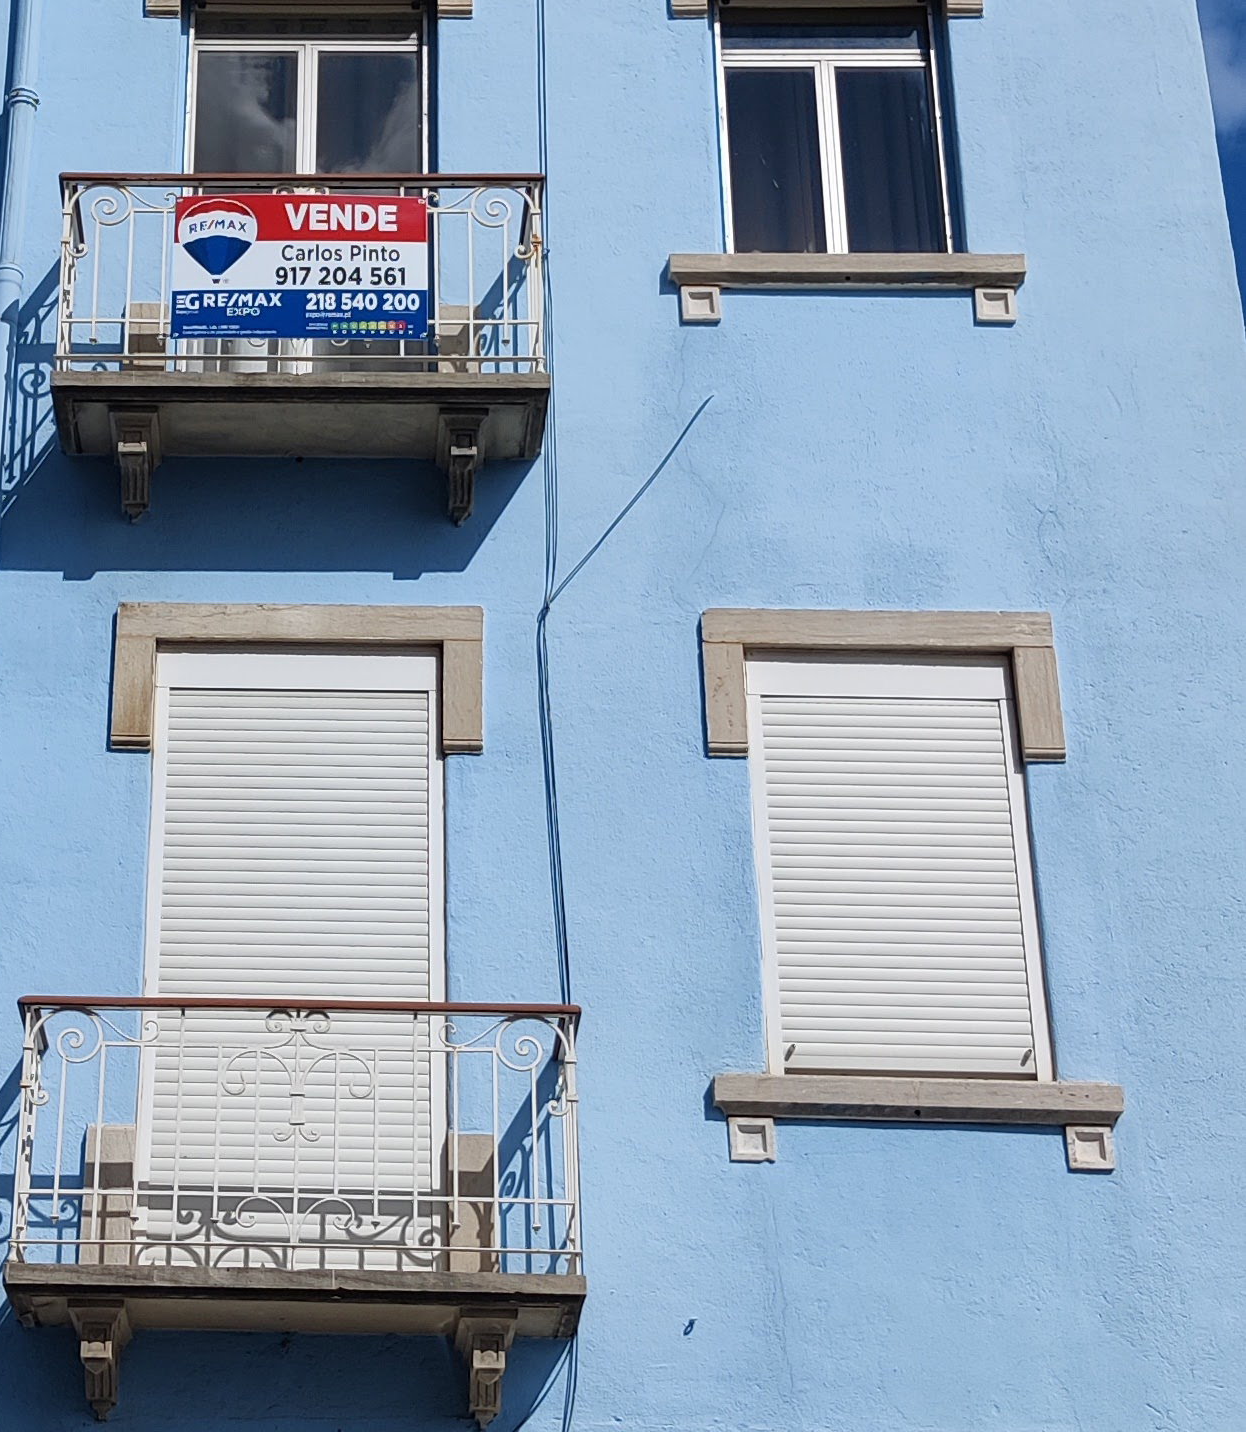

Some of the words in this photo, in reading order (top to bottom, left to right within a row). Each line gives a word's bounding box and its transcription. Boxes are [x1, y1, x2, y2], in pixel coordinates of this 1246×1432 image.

[188, 219, 247, 234] RE/MAX
[284, 203, 398, 232] VENDE
[281, 244, 343, 262] Carlos
[350, 244, 401, 262] Pinto
[275, 266, 311, 286] 917
[318, 266, 362, 286] 204
[369, 266, 406, 286] 561
[203, 292, 283, 308] RE/MAX
[305, 292, 337, 311] 218
[341, 292, 378, 311] 540
[382, 292, 420, 311] 200
